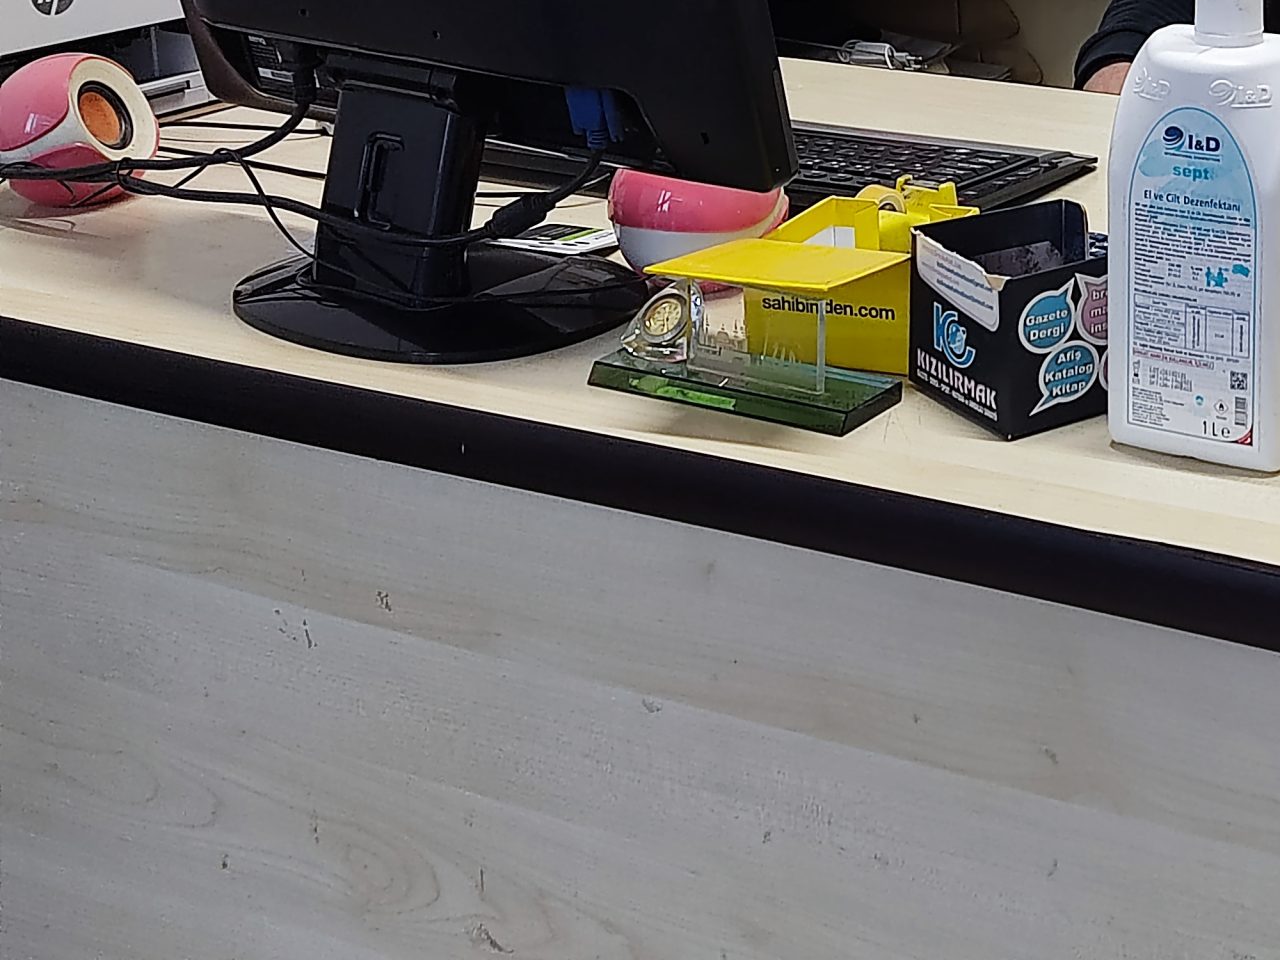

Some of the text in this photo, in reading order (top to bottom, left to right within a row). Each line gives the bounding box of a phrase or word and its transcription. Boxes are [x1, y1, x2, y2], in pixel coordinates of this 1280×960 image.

[1188, 134, 1221, 152] I&D
[1173, 166, 1210, 182] sept
[1144, 189, 1152, 200] El
[1154, 192, 1164, 201] ve
[1166, 193, 1181, 205] Cilt
[1092, 290, 1108, 301] br
[762, 296, 896, 321] sahibinden.com
[1025, 309, 1068, 326] Gazete
[1030, 323, 1065, 341] Dergi
[917, 348, 997, 410] KIZILIRMAK
[1045, 362, 1093, 383] Katalog
[1052, 380, 1087, 397] Kitap
